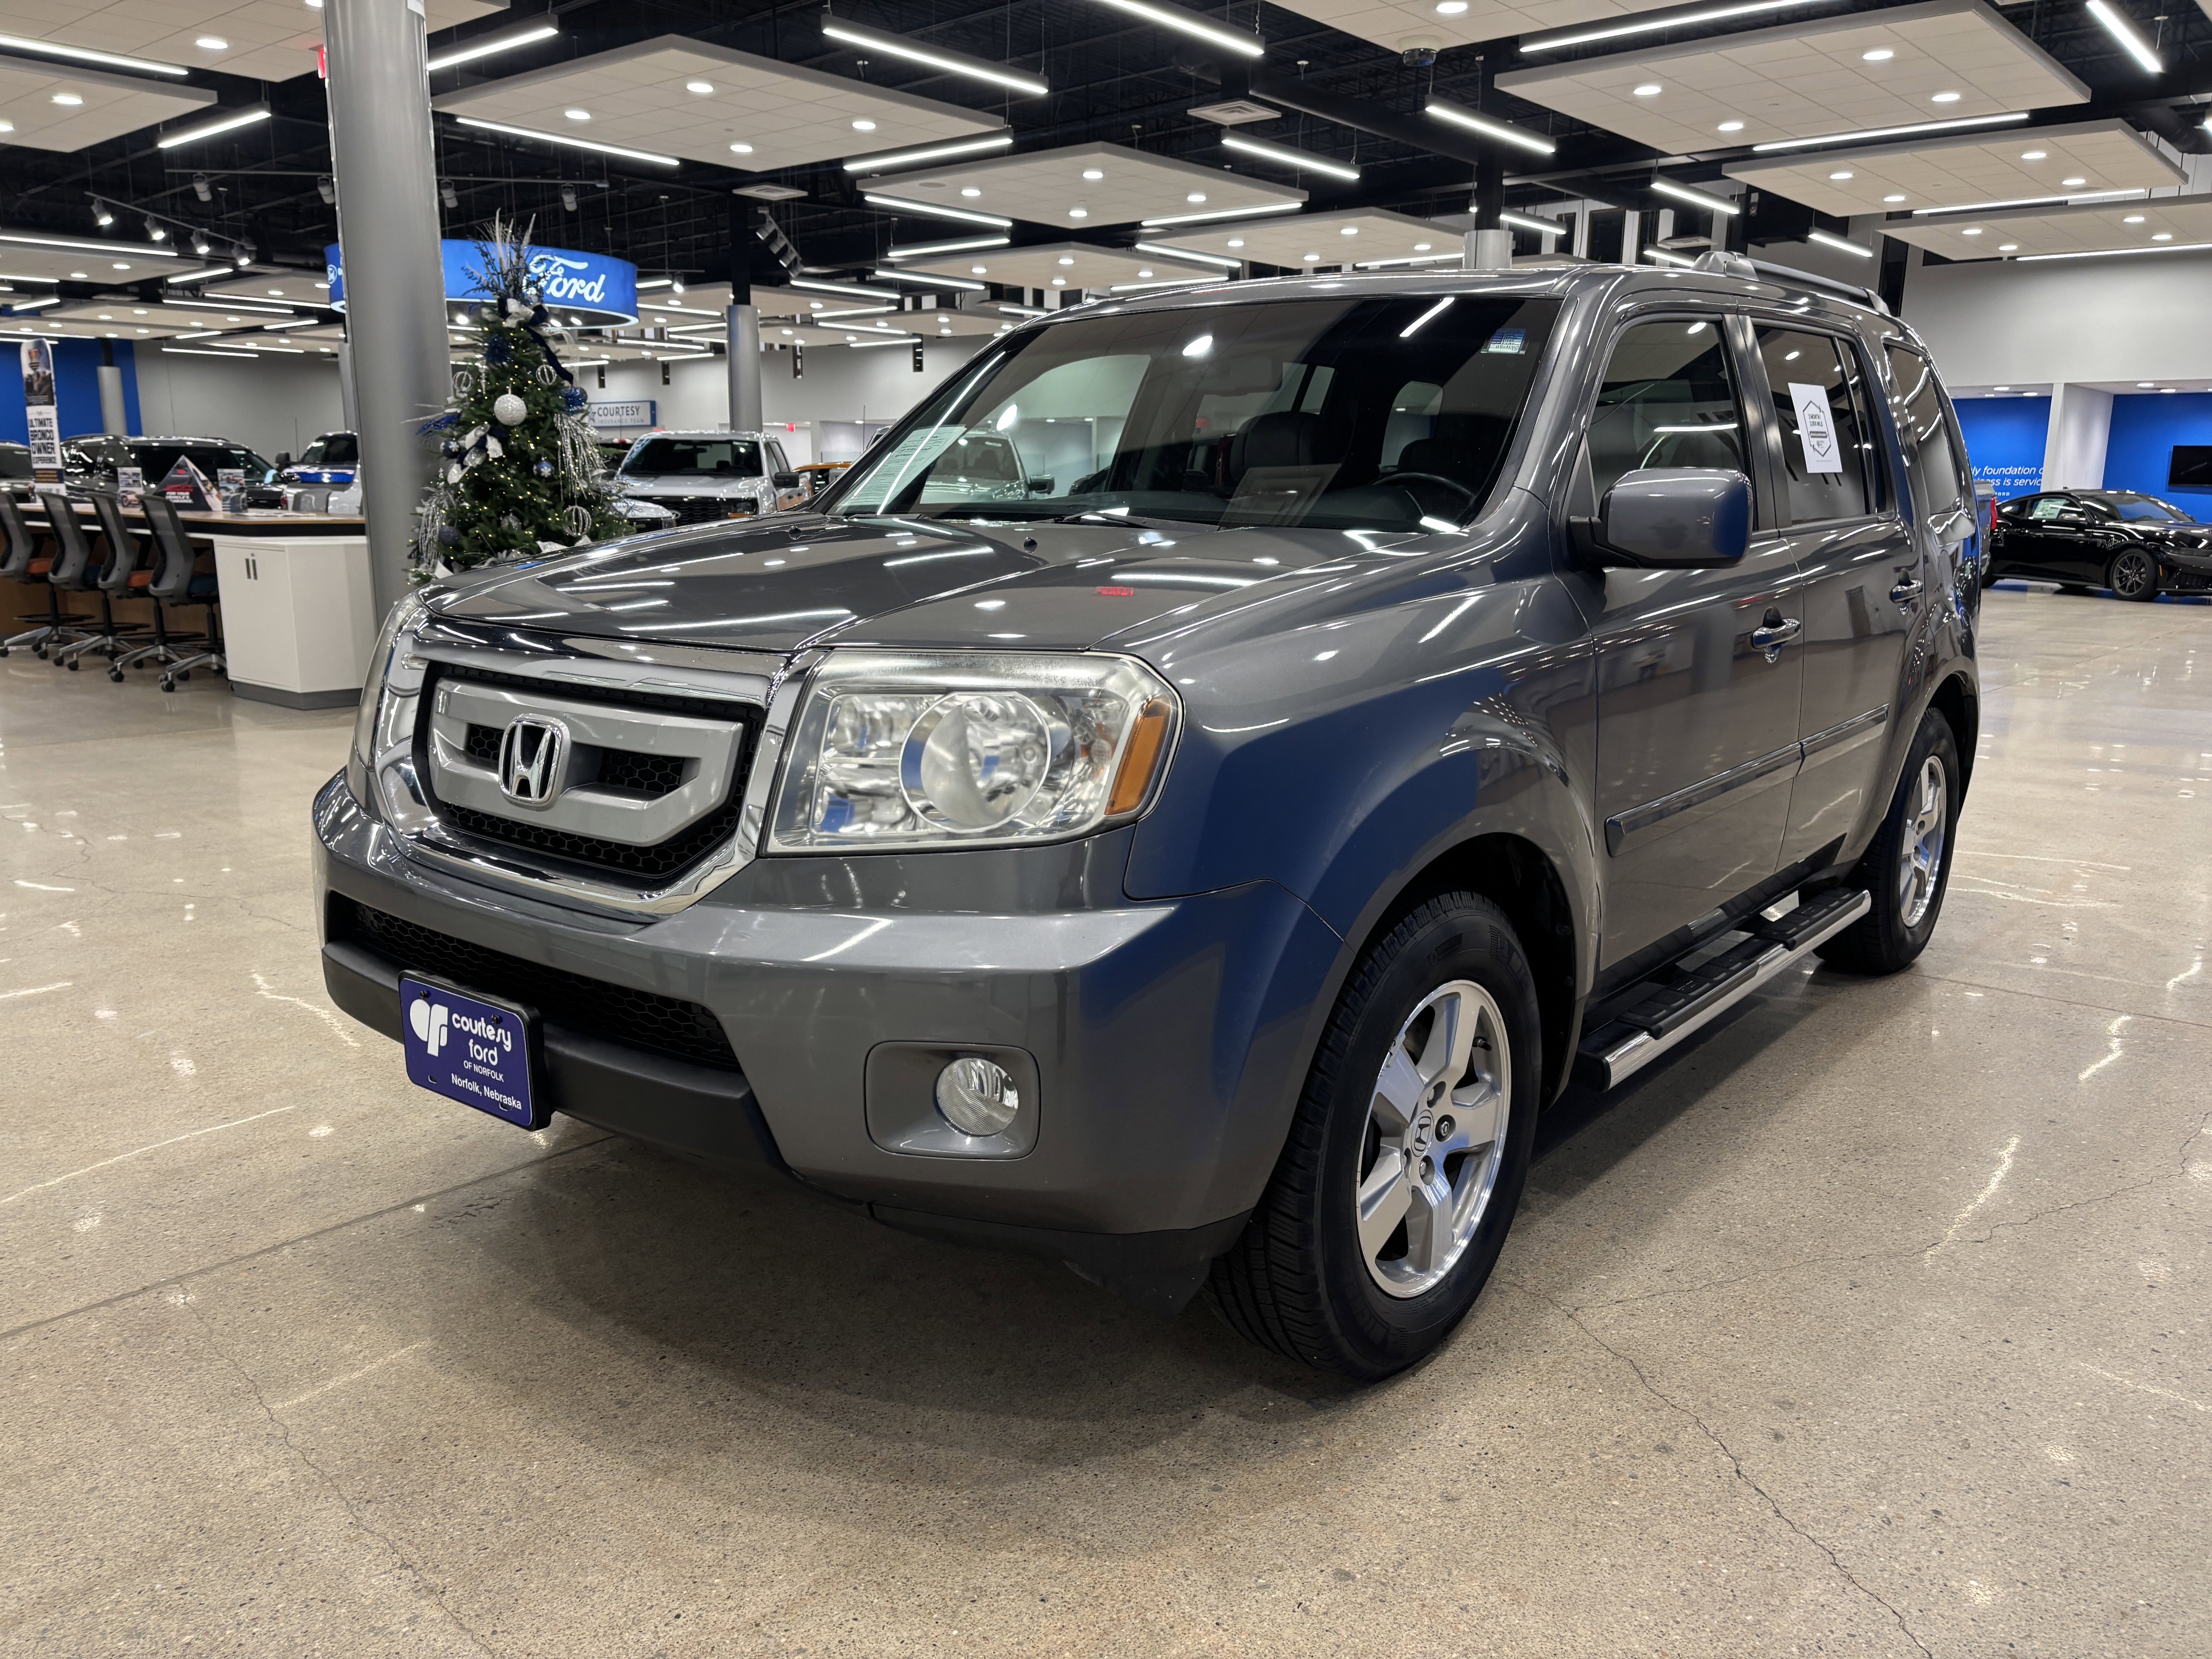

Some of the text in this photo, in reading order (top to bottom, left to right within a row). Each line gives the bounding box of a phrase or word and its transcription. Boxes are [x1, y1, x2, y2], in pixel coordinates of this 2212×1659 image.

[522, 254, 606, 303] Ford
[597, 405, 640, 417] COURTESY
[28, 418, 53, 428] ULTIMATE
[29, 429, 54, 441] BRONCO
[31, 442, 55, 454] OWNER
[1971, 465, 1981, 476] ly
[1982, 465, 2037, 476] foundation
[2003, 477, 2011, 486] is
[2013, 477, 2042, 486] servic
[452, 1013, 512, 1052] courtesy
[469, 1039, 498, 1066] ford
[463, 1060, 504, 1082] OF NORFOLK
[452, 1073, 522, 1110] Norfolk, Nebraska
